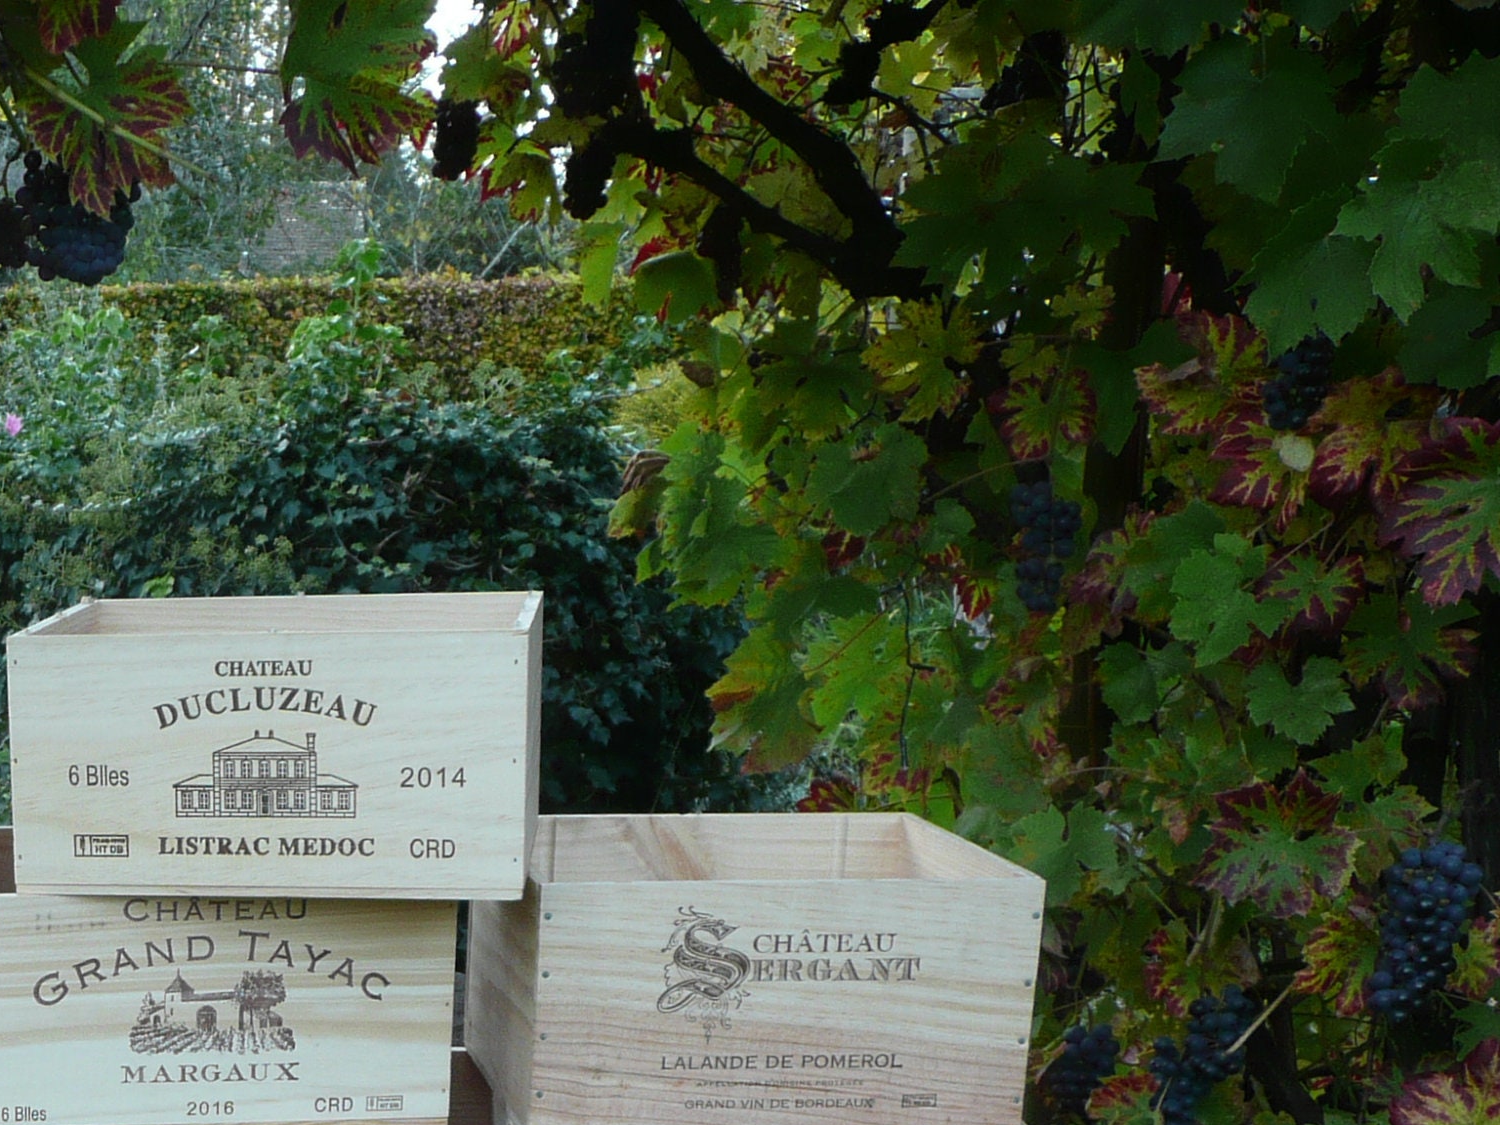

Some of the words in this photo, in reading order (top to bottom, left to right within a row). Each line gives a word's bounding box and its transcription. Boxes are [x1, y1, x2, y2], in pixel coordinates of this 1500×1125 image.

[214, 660, 313, 677] CHATEAU
[153, 685, 378, 730] DUCLUZEAU
[69, 764, 80, 785] 6
[400, 767, 467, 788] 2014
[158, 836, 271, 855] LISTRAC
[278, 837, 376, 856] MEDOC
[409, 838, 455, 858] CRD
[753, 929, 898, 953] CHÂTEAU
[32, 935, 214, 1007] GRAND
[239, 930, 392, 1001] TAYAC
[660, 1053, 759, 1071] LALANDE
[765, 1053, 796, 1069] DE
[800, 1052, 904, 1070] POMEROL
[121, 1062, 300, 1083] MARGAUX
[1, 1107, 9, 1121] 6
[186, 1101, 234, 1116] 2016
[314, 1097, 353, 1113] CRD
[684, 1098, 736, 1110] GRAND
[741, 1098, 764, 1109] VIN
[770, 1098, 790, 1108] DE
[795, 1098, 875, 1109] BORDEAUX
